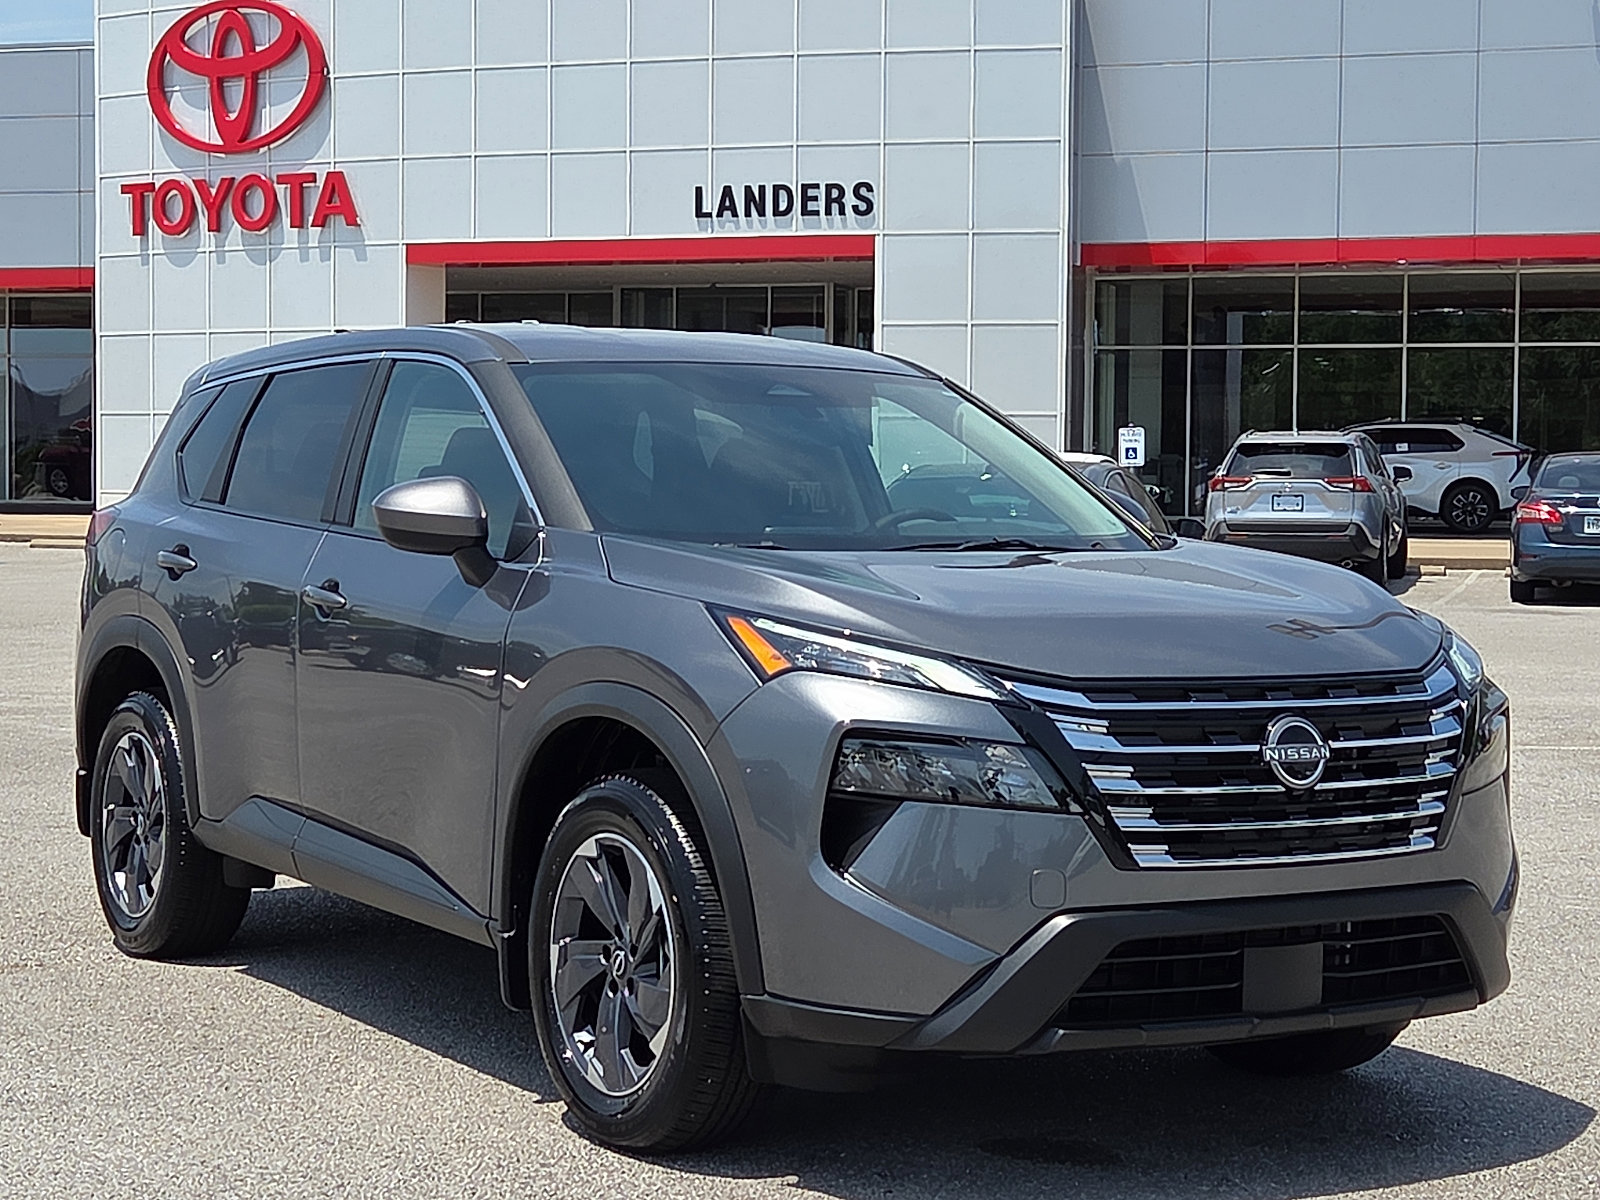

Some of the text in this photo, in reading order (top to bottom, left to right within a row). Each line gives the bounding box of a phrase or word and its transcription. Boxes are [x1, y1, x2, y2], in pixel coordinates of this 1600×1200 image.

[120, 170, 361, 237] TOYOTA
[694, 181, 875, 219] LANDERS
[1265, 746, 1330, 761] NISSAN
